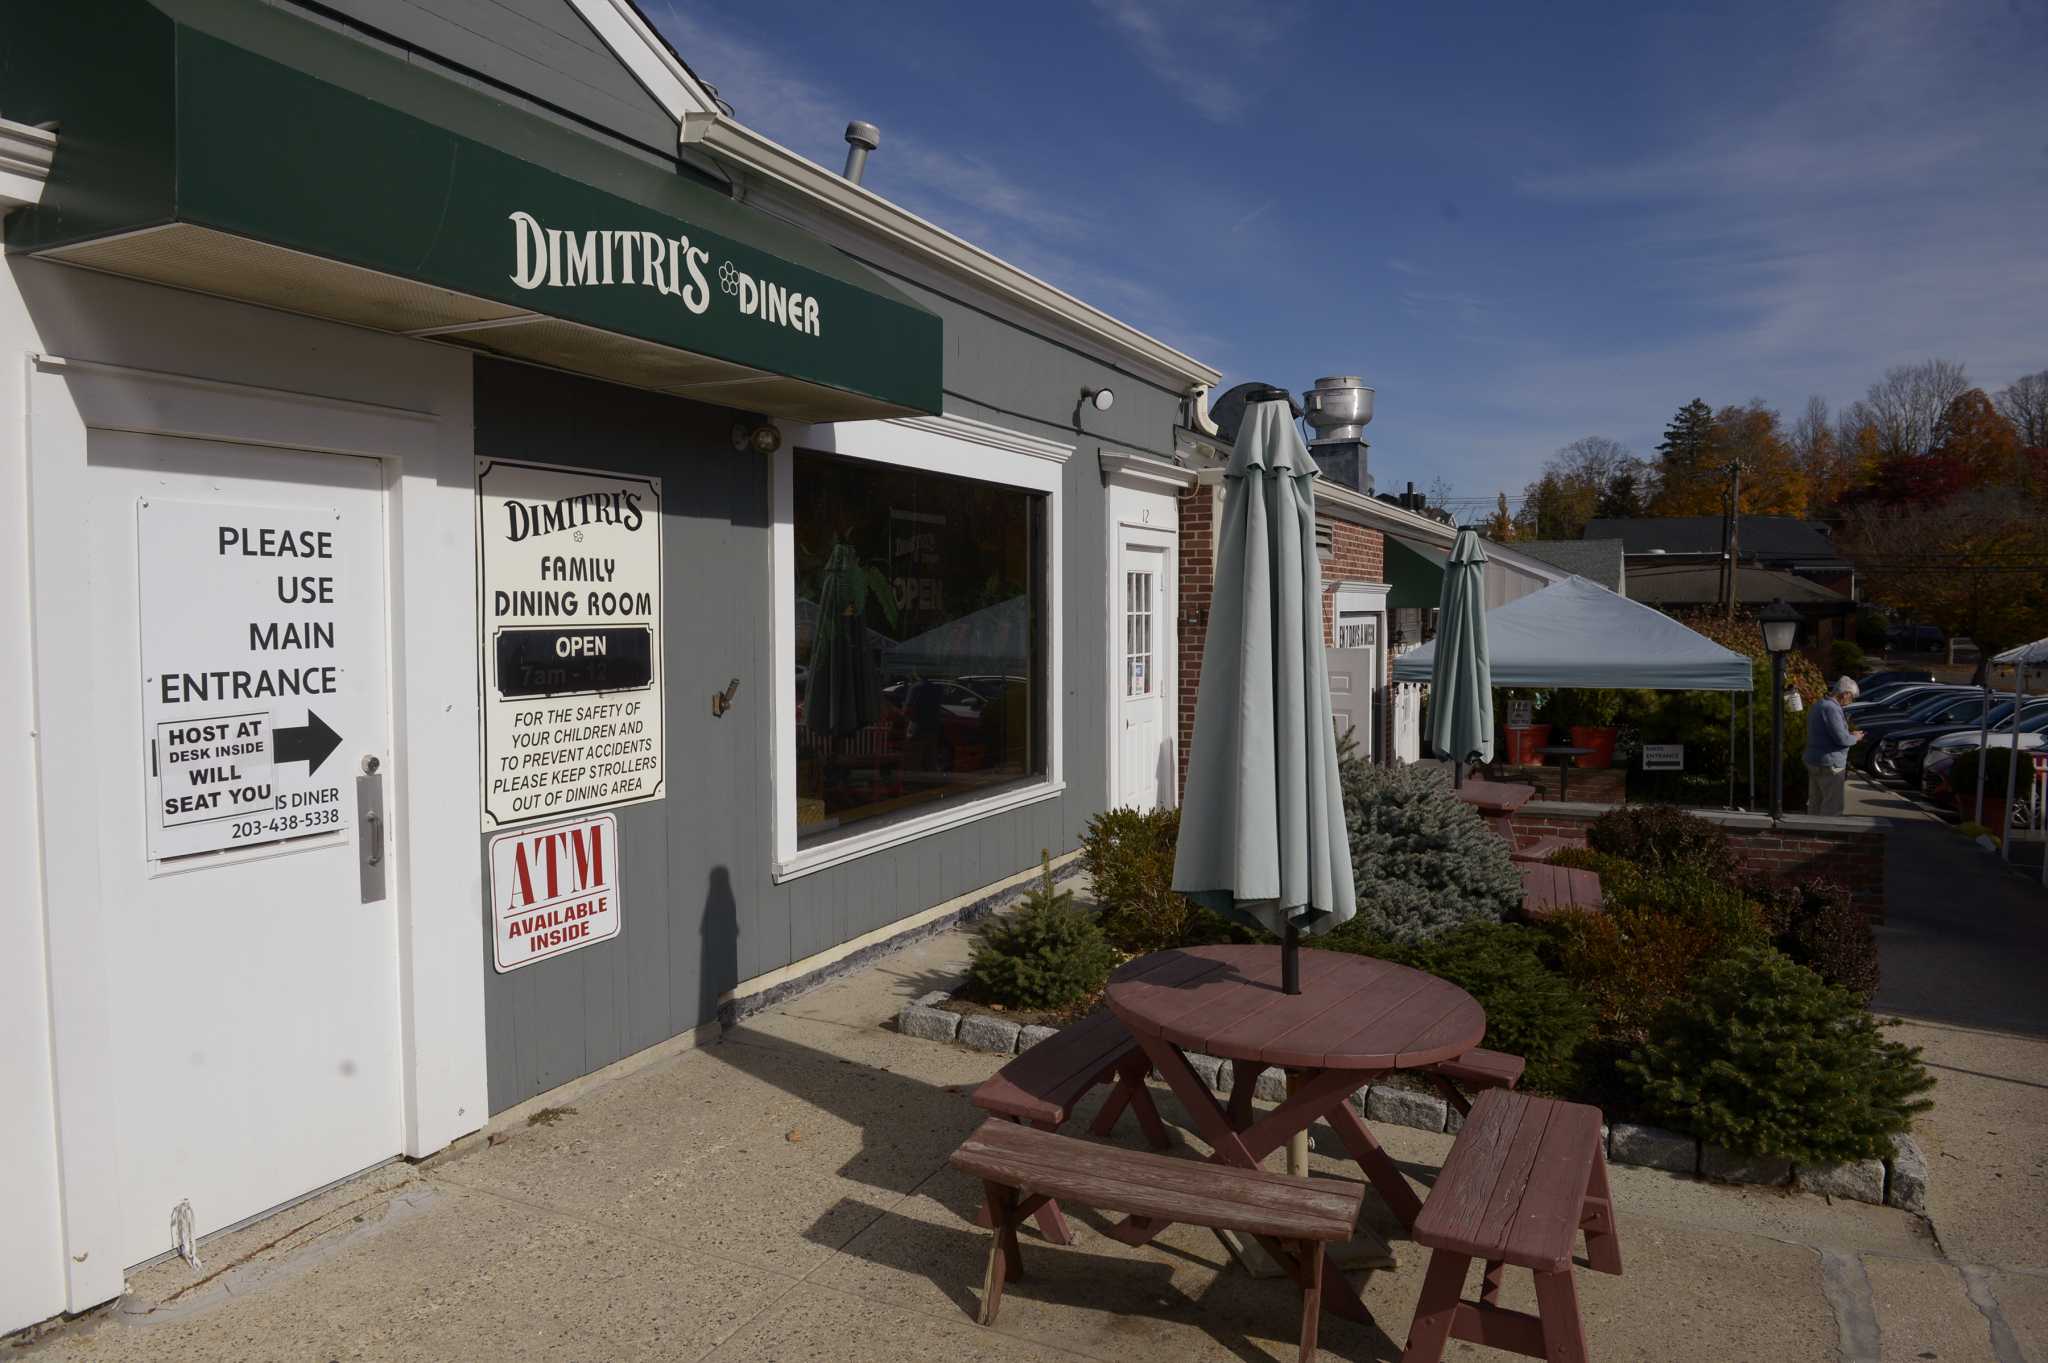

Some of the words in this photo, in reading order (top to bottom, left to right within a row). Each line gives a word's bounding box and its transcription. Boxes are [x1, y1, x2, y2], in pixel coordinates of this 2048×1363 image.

[508, 211, 710, 314] DIMITRI'S
[738, 271, 820, 337] DINER
[503, 489, 643, 542] DIMITRI'S
[219, 526, 333, 559] PLEASE
[541, 556, 615, 582] FAMILY
[277, 576, 334, 604] USE
[494, 590, 579, 617] DINING
[587, 591, 652, 616] ROOM
[250, 622, 334, 651] MAIN
[555, 635, 607, 658] OPEN
[161, 666, 337, 704] ENTRANCE
[514, 711, 543, 728] FOR
[547, 708, 573, 724] THE
[576, 703, 622, 721] SAFETY
[625, 701, 641, 716] OF
[168, 724, 229, 746] HOST
[236, 720, 262, 738] AT
[512, 731, 550, 749] YOUR
[554, 723, 616, 744] CHILDREN
[619, 720, 643, 736] AND
[169, 747, 212, 763] DESK
[215, 741, 264, 758] INSIDE
[500, 755, 519, 772] TO
[522, 746, 584, 769] PREVENT
[586, 738, 652, 761] ACCIDENTS
[189, 765, 242, 786] WILL
[493, 772, 548, 794] PLEASE
[551, 766, 586, 785] KEEP
[589, 756, 657, 779] STROLLERS
[165, 791, 222, 815] SEAT
[228, 784, 272, 804] YOU
[291, 787, 340, 807] DINER
[512, 794, 541, 812] OUT
[544, 790, 563, 806] OF
[565, 783, 608, 803] DINING
[611, 777, 642, 795] AREA
[231, 808, 340, 839] 203-438-5338
[507, 823, 606, 911] ATM
[508, 896, 608, 940] AVAILABLE
[530, 920, 590, 953] INSIDE
